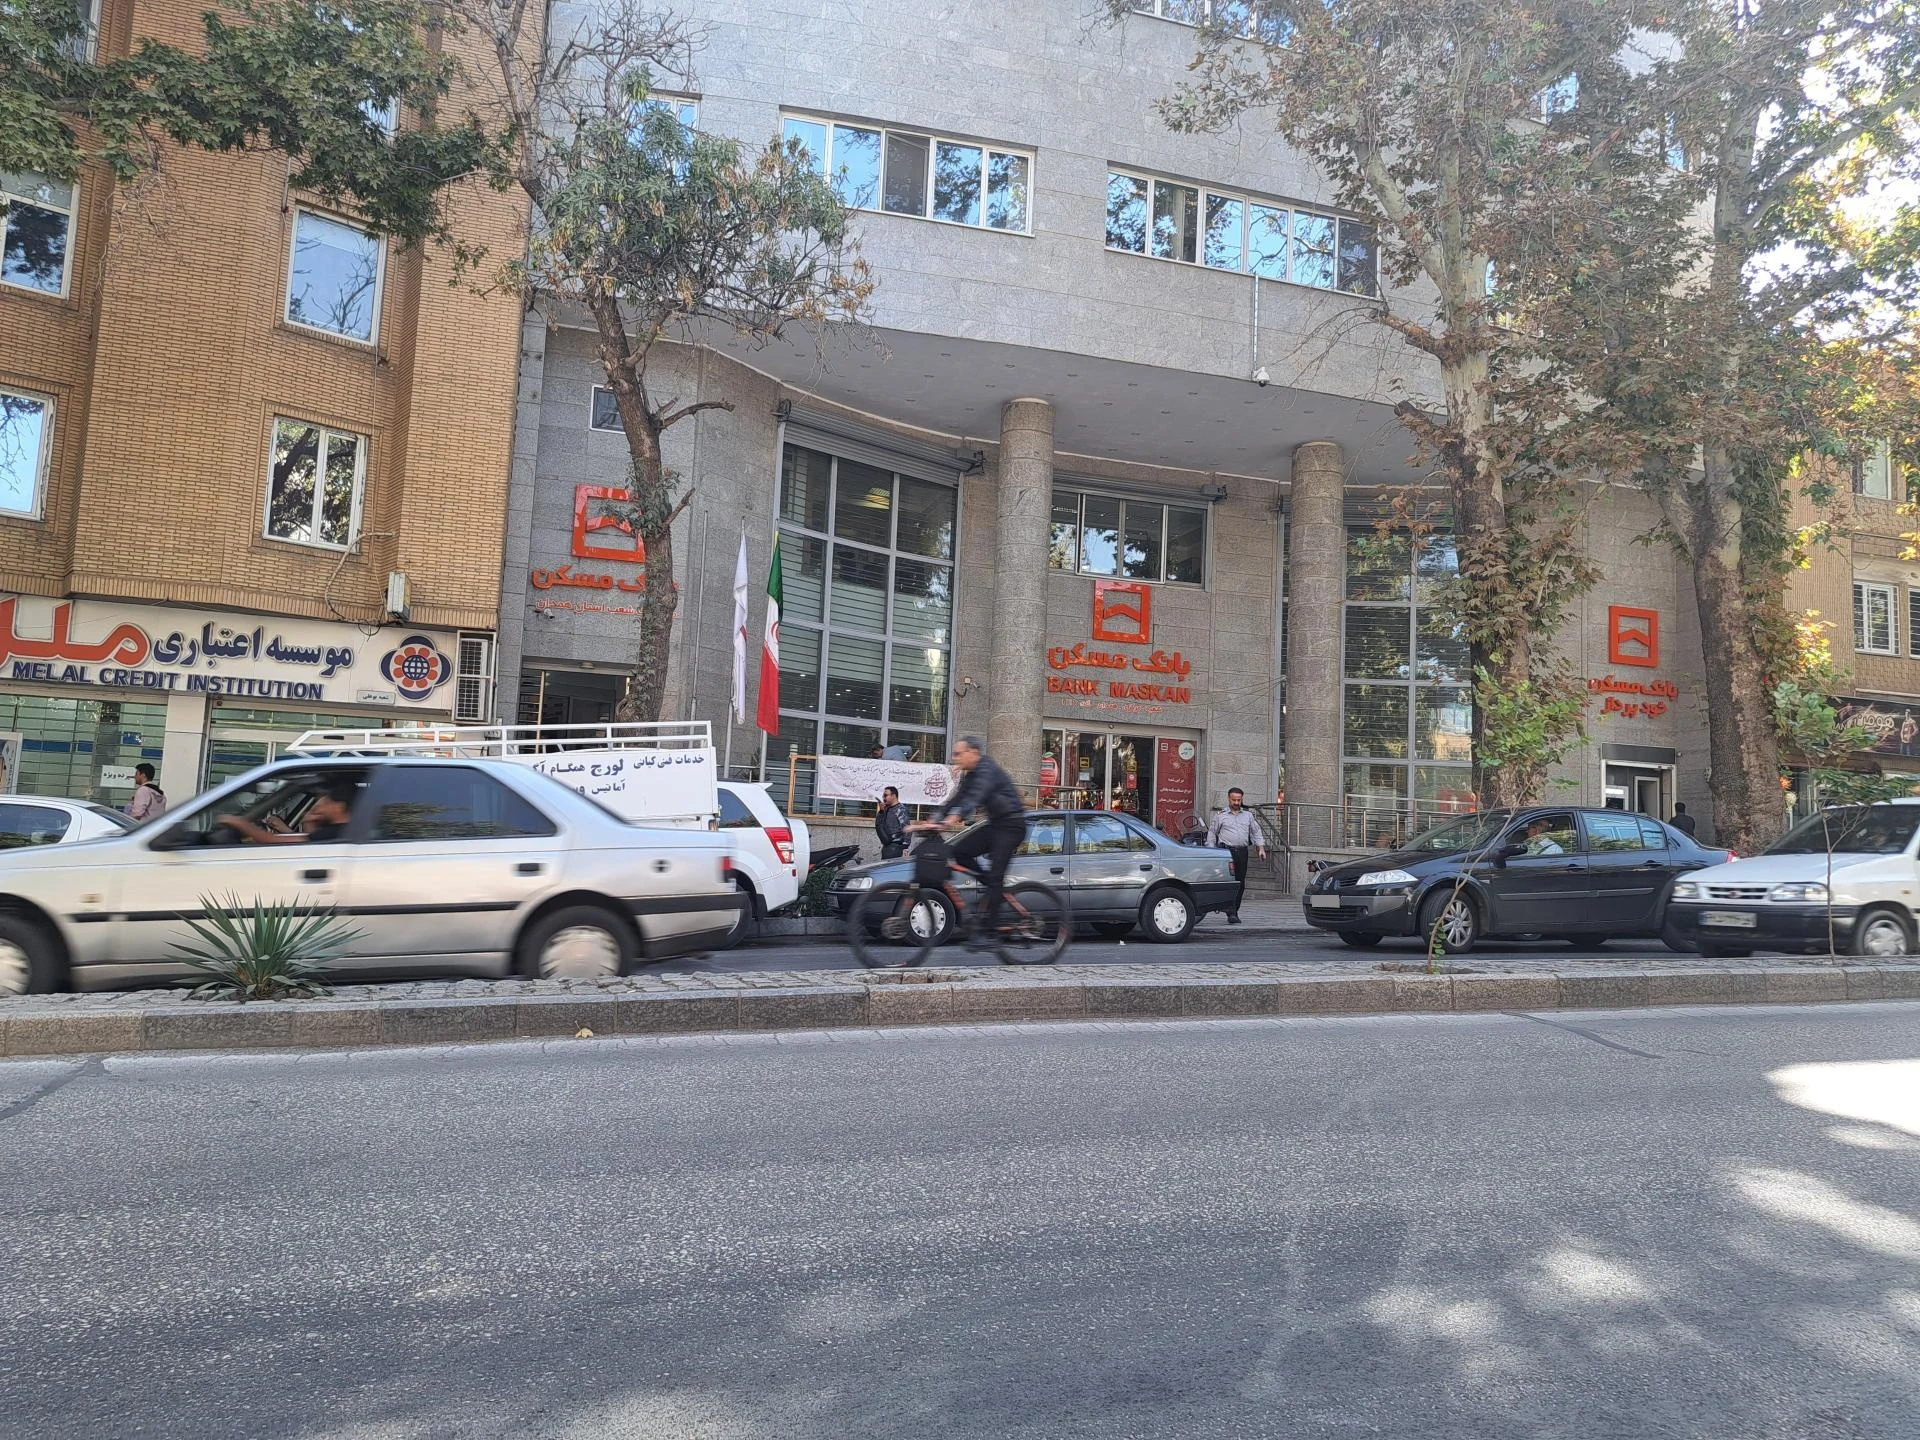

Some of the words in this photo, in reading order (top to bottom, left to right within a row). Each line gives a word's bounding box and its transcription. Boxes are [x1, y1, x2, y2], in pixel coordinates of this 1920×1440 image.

[531, 564, 613, 590] مسکن
[535, 597, 574, 610] همدان
[574, 600, 605, 613] استان
[151, 620, 264, 669] اعتباری
[265, 634, 354, 678] موسسه
[1048, 642, 1128, 670] مسکن
[1132, 650, 1191, 683] بانک
[12, 660, 93, 684] MELAL
[99, 668, 179, 690] CREDIT
[186, 674, 325, 700] INSTITUTION
[1047, 676, 1099, 697] BANK
[1109, 682, 1191, 704] MASKAN
[1588, 674, 1640, 695] مسکن
[1640, 680, 1679, 701] بانک
[1600, 697, 1639, 719] پرداز
[1640, 701, 1668, 719] خود
[590, 758, 624, 777] لورچ
[633, 755, 656, 769] کیانی
[657, 753, 673, 769] فنی
[675, 753, 705, 765] خدمات
